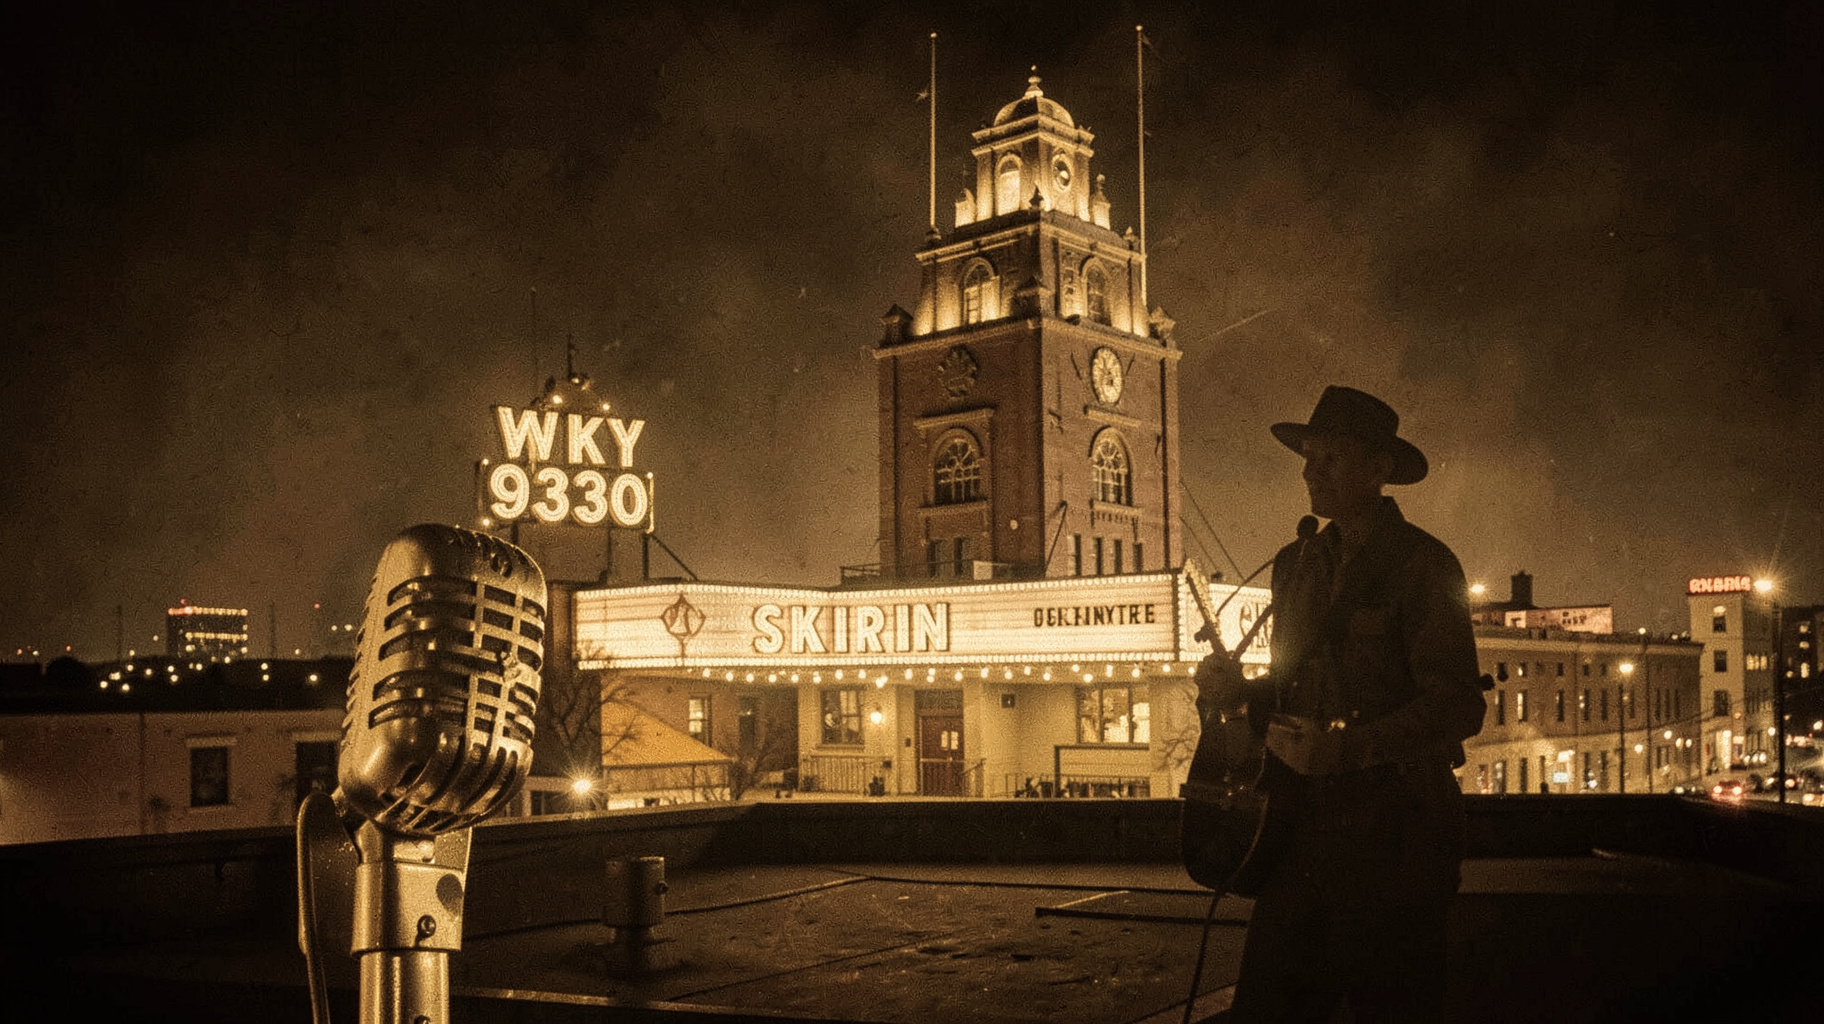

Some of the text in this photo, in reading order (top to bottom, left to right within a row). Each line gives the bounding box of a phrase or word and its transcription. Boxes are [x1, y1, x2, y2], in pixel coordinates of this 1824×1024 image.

[497, 405, 646, 468] WKY
[489, 463, 649, 526] 9330
[752, 602, 951, 654] SKIRIN
